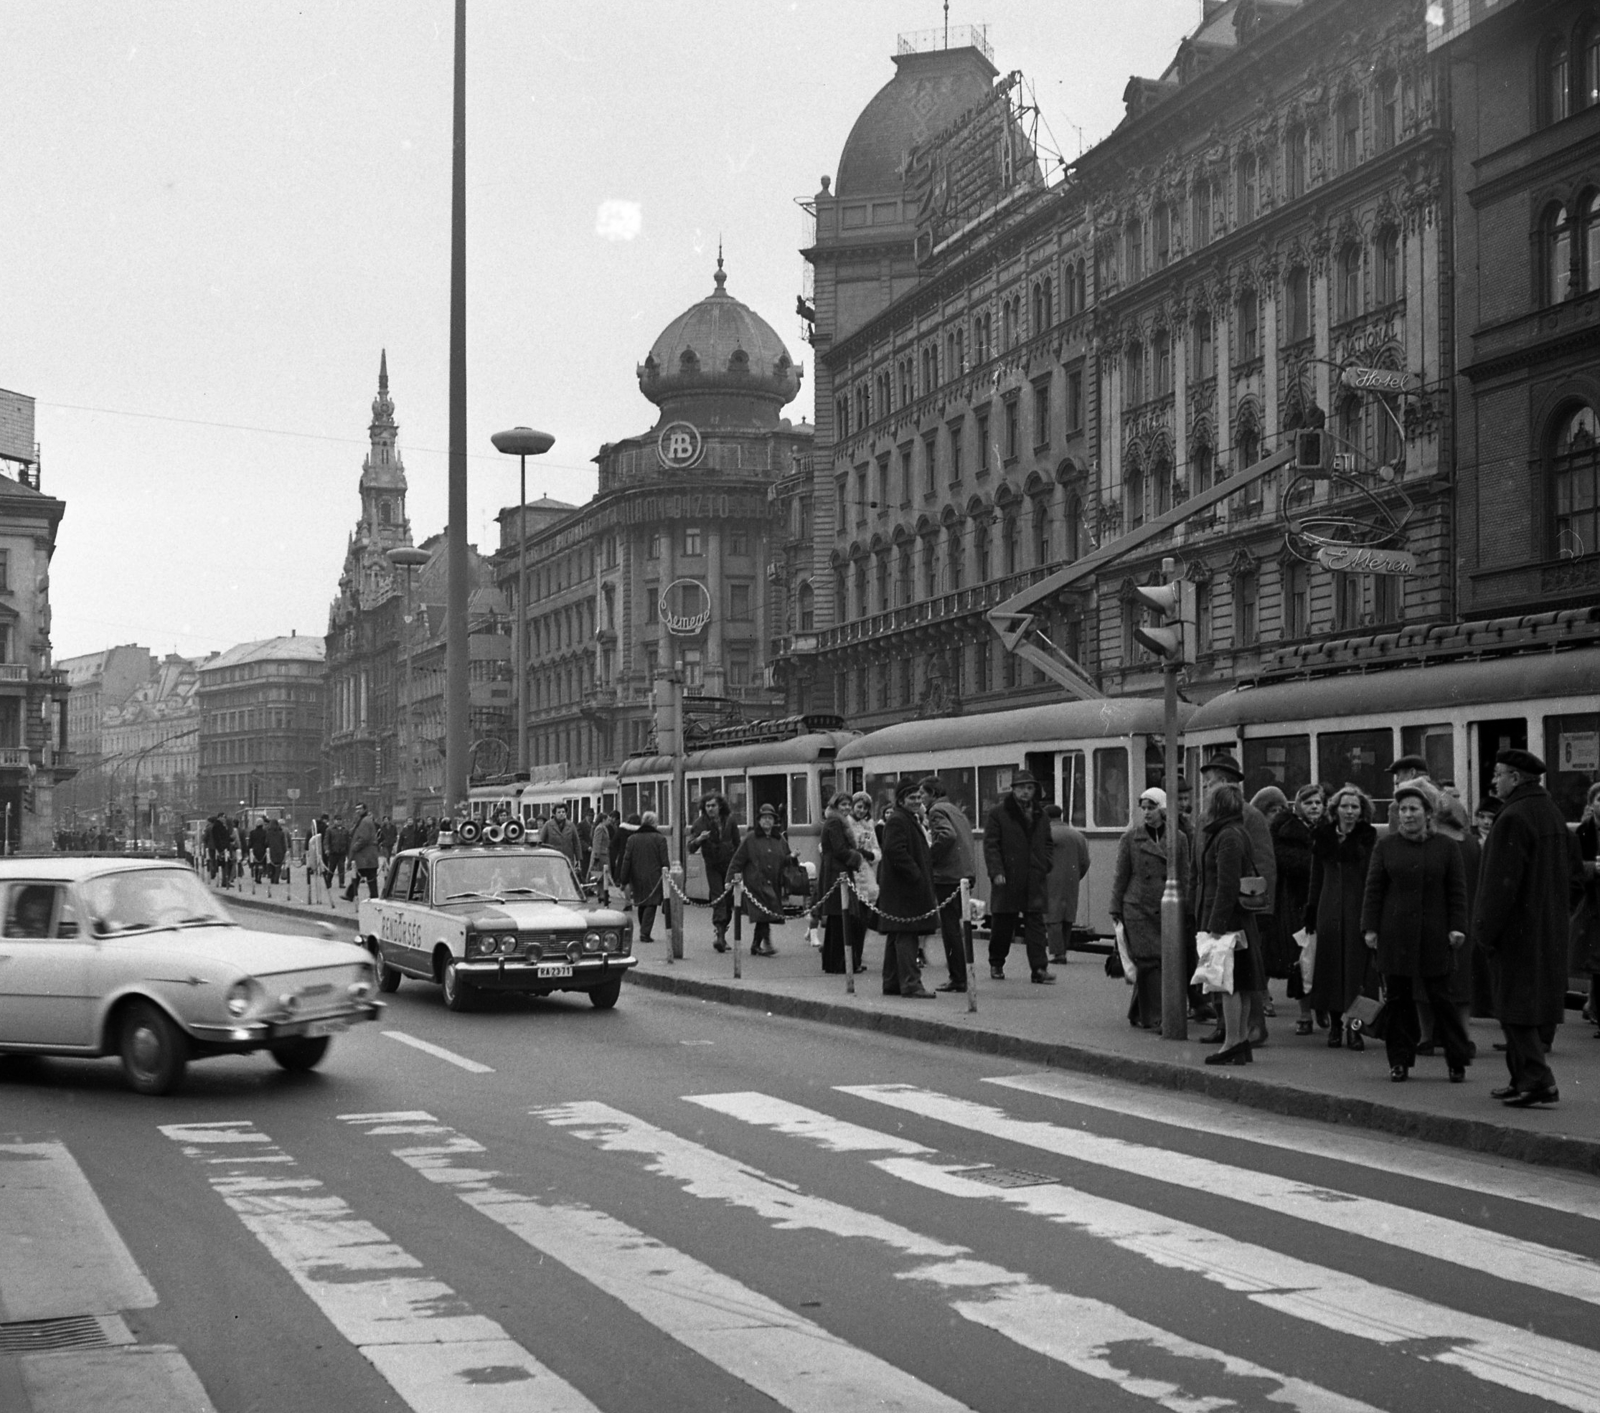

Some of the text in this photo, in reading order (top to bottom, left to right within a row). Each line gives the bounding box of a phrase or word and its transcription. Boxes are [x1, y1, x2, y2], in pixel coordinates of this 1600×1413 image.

[1341, 321, 1399, 360] NATIONAL
[1356, 368, 1410, 391] Hotel
[1566, 742, 1572, 763] 6
